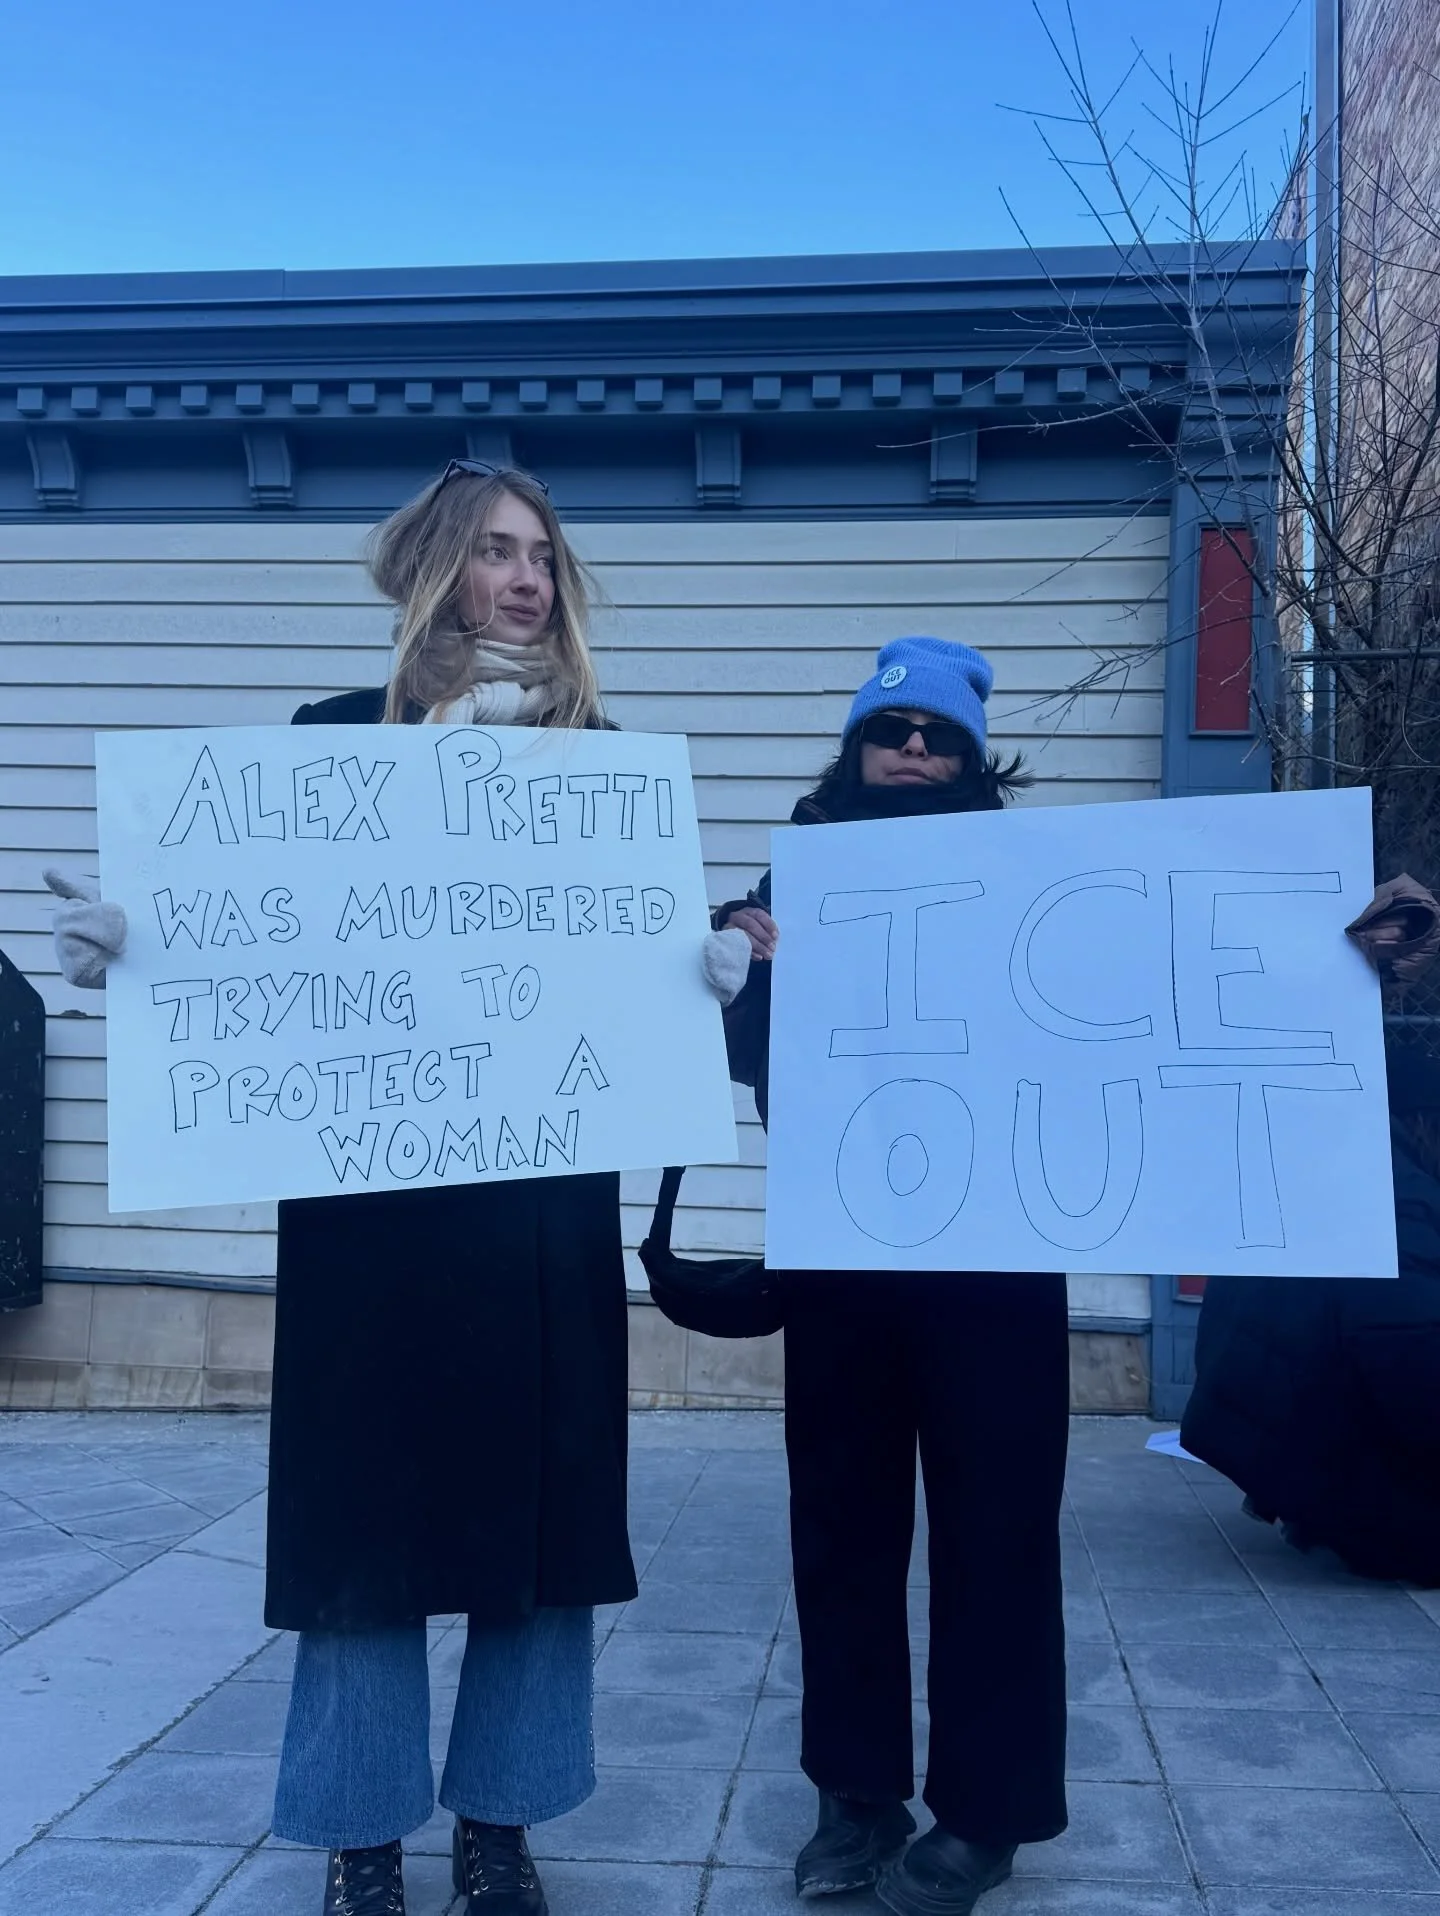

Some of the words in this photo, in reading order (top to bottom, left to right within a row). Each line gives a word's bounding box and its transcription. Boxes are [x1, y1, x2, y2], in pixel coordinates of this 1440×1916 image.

[884, 673, 902, 684] OUT
[887, 667, 902, 677] ICE
[159, 744, 396, 848] ALEX
[434, 728, 675, 845] PRETTI
[152, 887, 301, 949] WAS
[335, 881, 676, 943] MURDERED
[151, 969, 418, 1043] TRYING
[461, 963, 542, 1021] TO
[819, 868, 1342, 1060] ICE
[168, 1042, 492, 1134] PROTECT
[555, 1033, 611, 1097] A
[317, 1109, 581, 1184] WOMAN
[835, 1062, 1364, 1252] OUT
